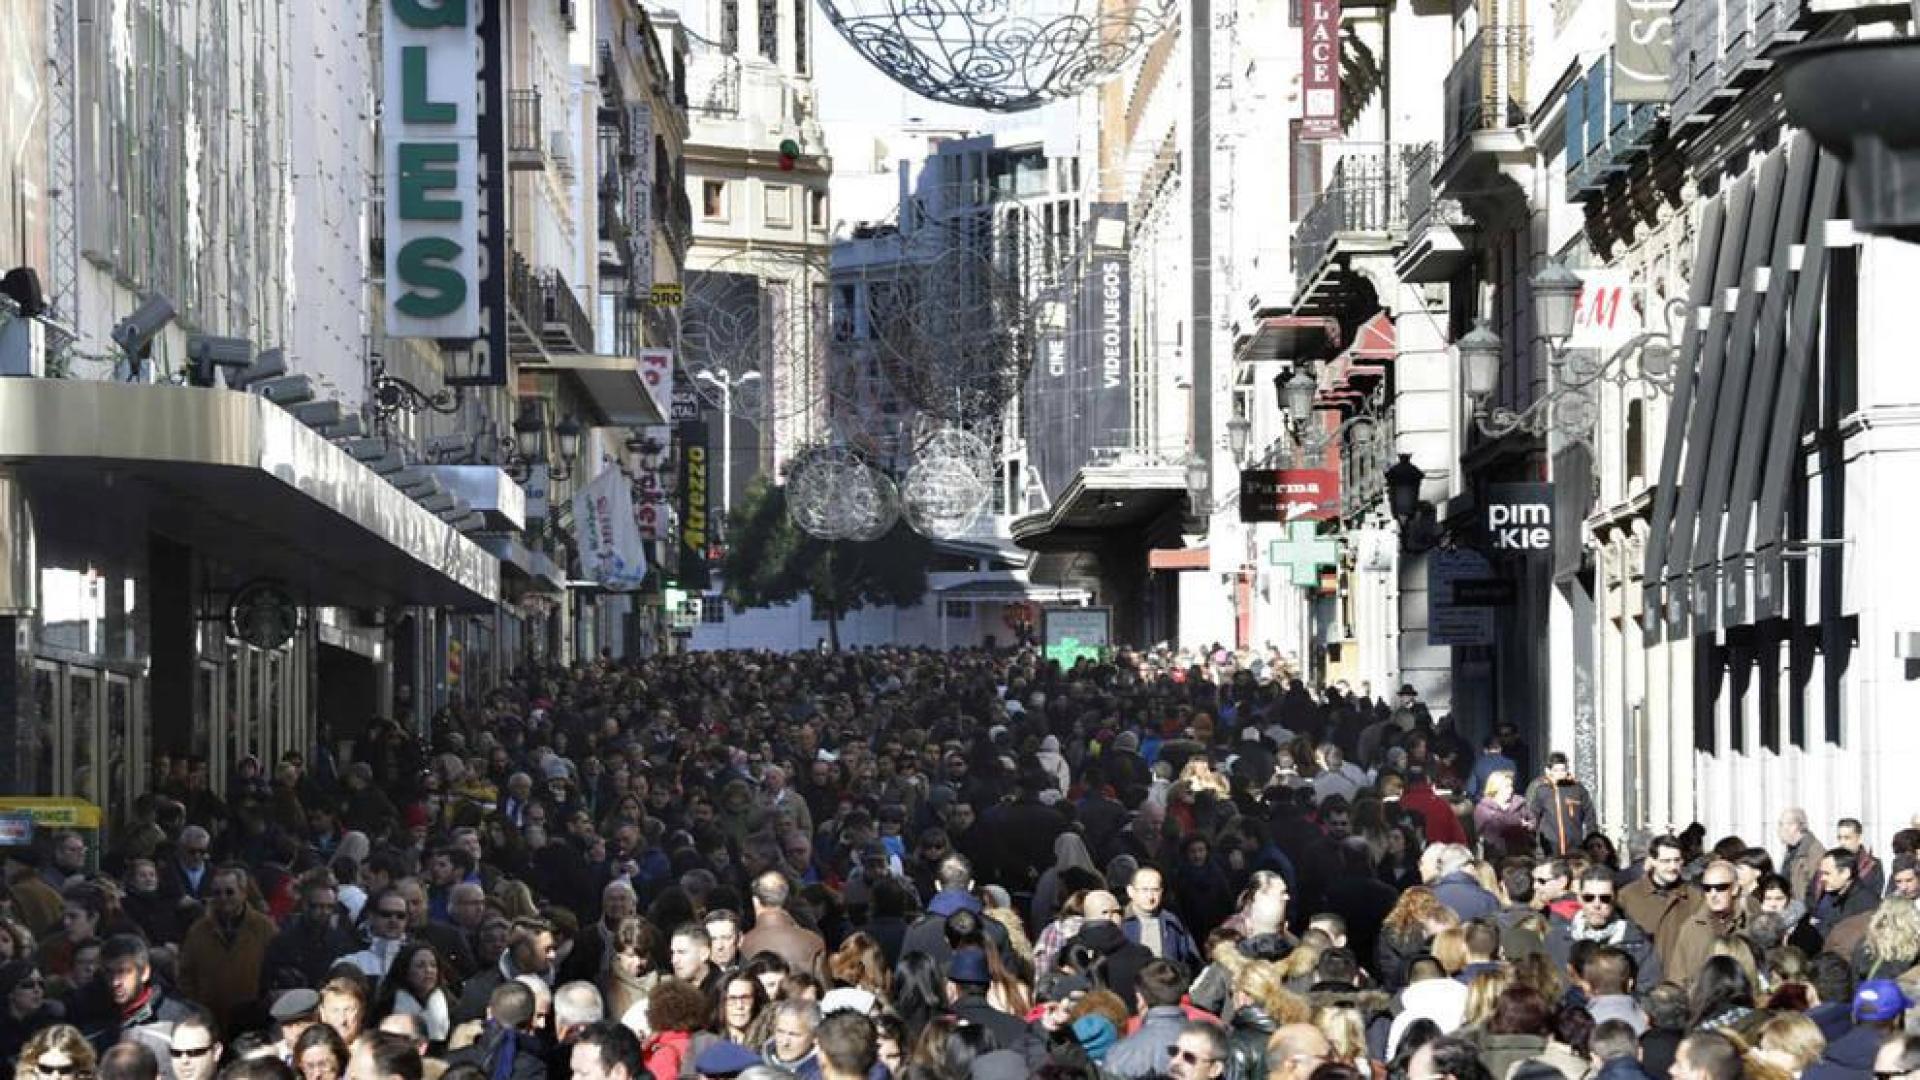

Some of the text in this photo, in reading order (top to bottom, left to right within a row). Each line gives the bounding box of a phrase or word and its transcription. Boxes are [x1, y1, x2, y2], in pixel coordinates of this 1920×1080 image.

[1103, 261, 1120, 389] VIDEOJUEGOS
[1049, 339, 1064, 377] CINE
[1488, 503, 1551, 531] pim
